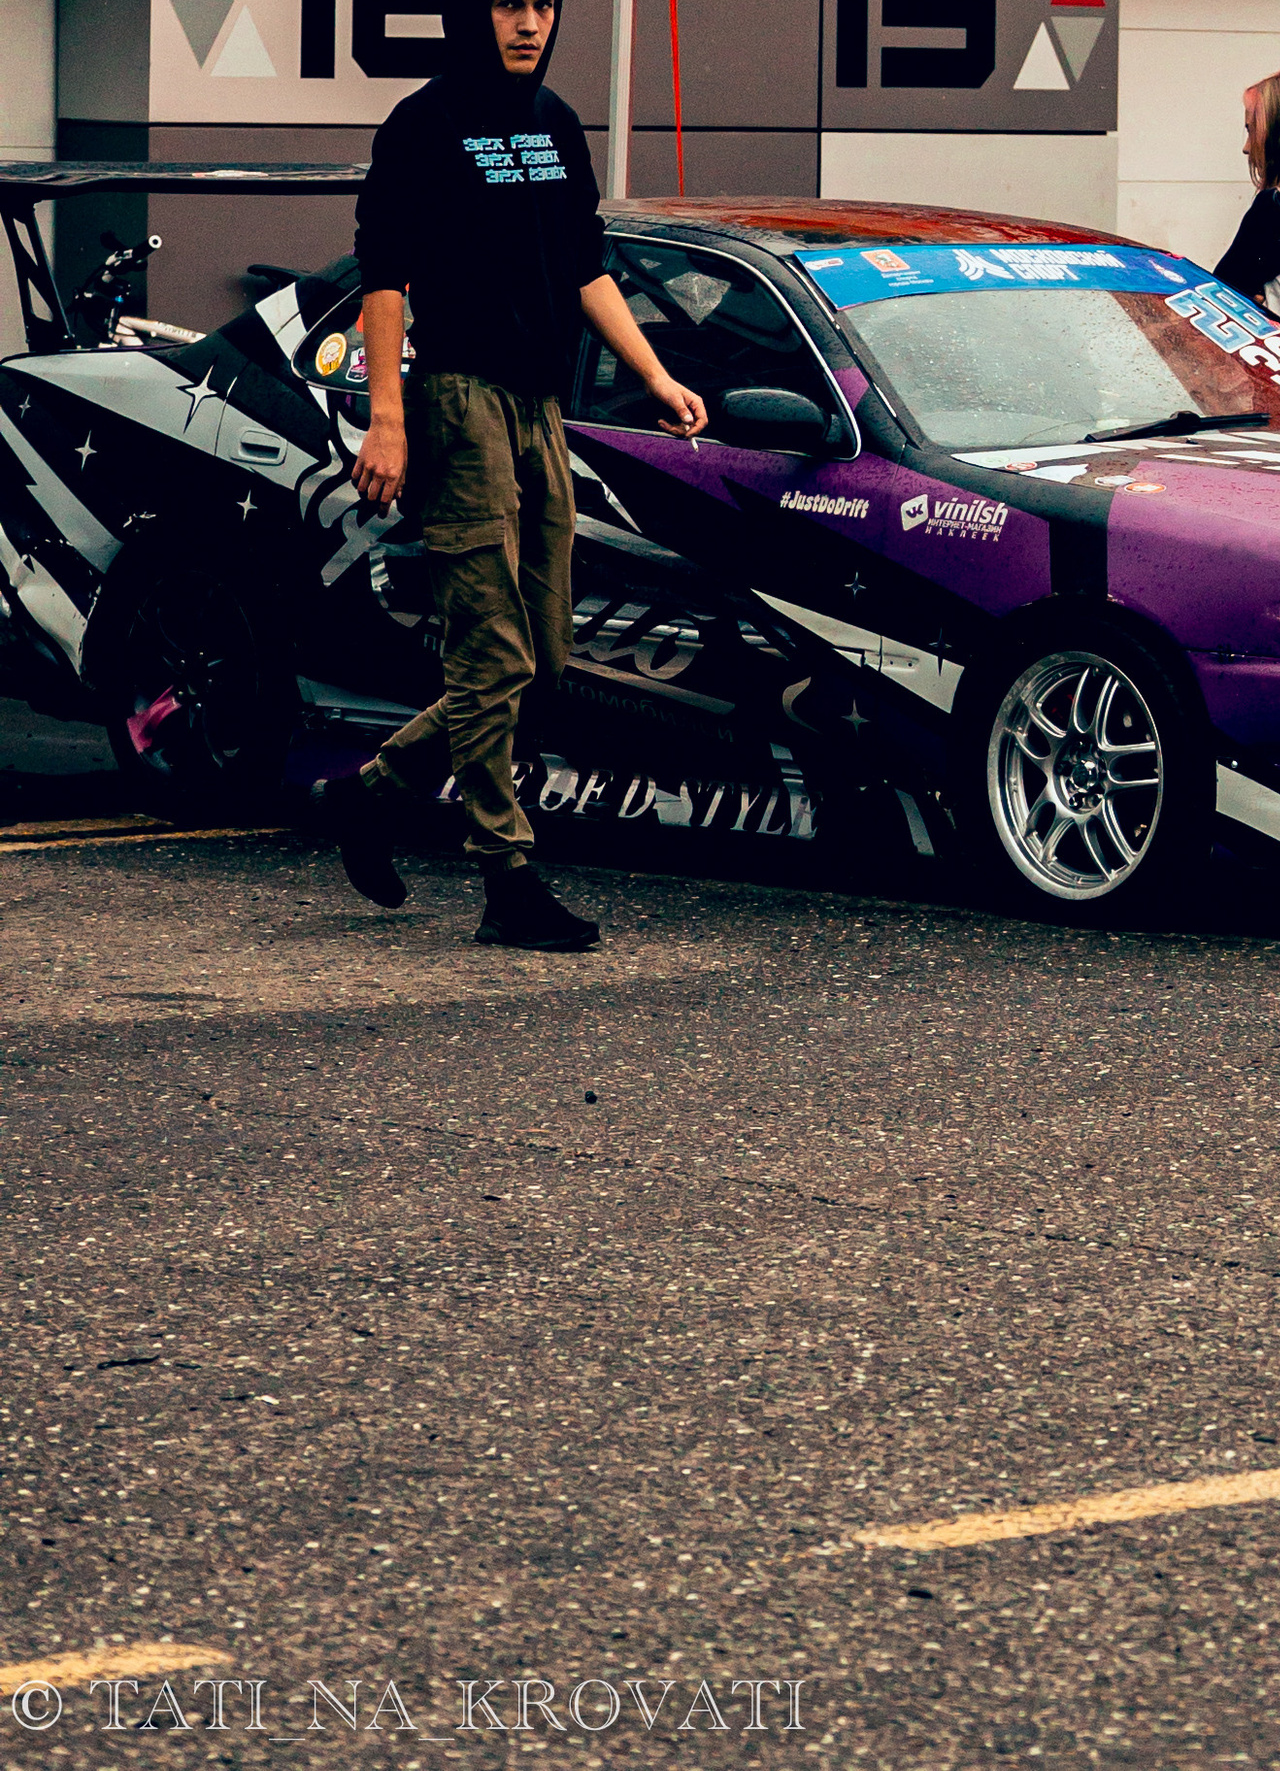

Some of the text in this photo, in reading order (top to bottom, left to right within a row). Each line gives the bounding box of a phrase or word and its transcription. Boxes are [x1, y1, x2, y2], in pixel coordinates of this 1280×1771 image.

[988, 248, 1126, 269] МОСКОВСКИЙ
[1007, 263, 1080, 281] СПОРТ
[779, 490, 870, 519] #JustDoDrift
[934, 497, 1009, 526] vinilsh
[925, 525, 1000, 543] НАКЛЕЕК
[927, 518, 1003, 534] ИНТЕРНЕТ-МАГАЗИН
